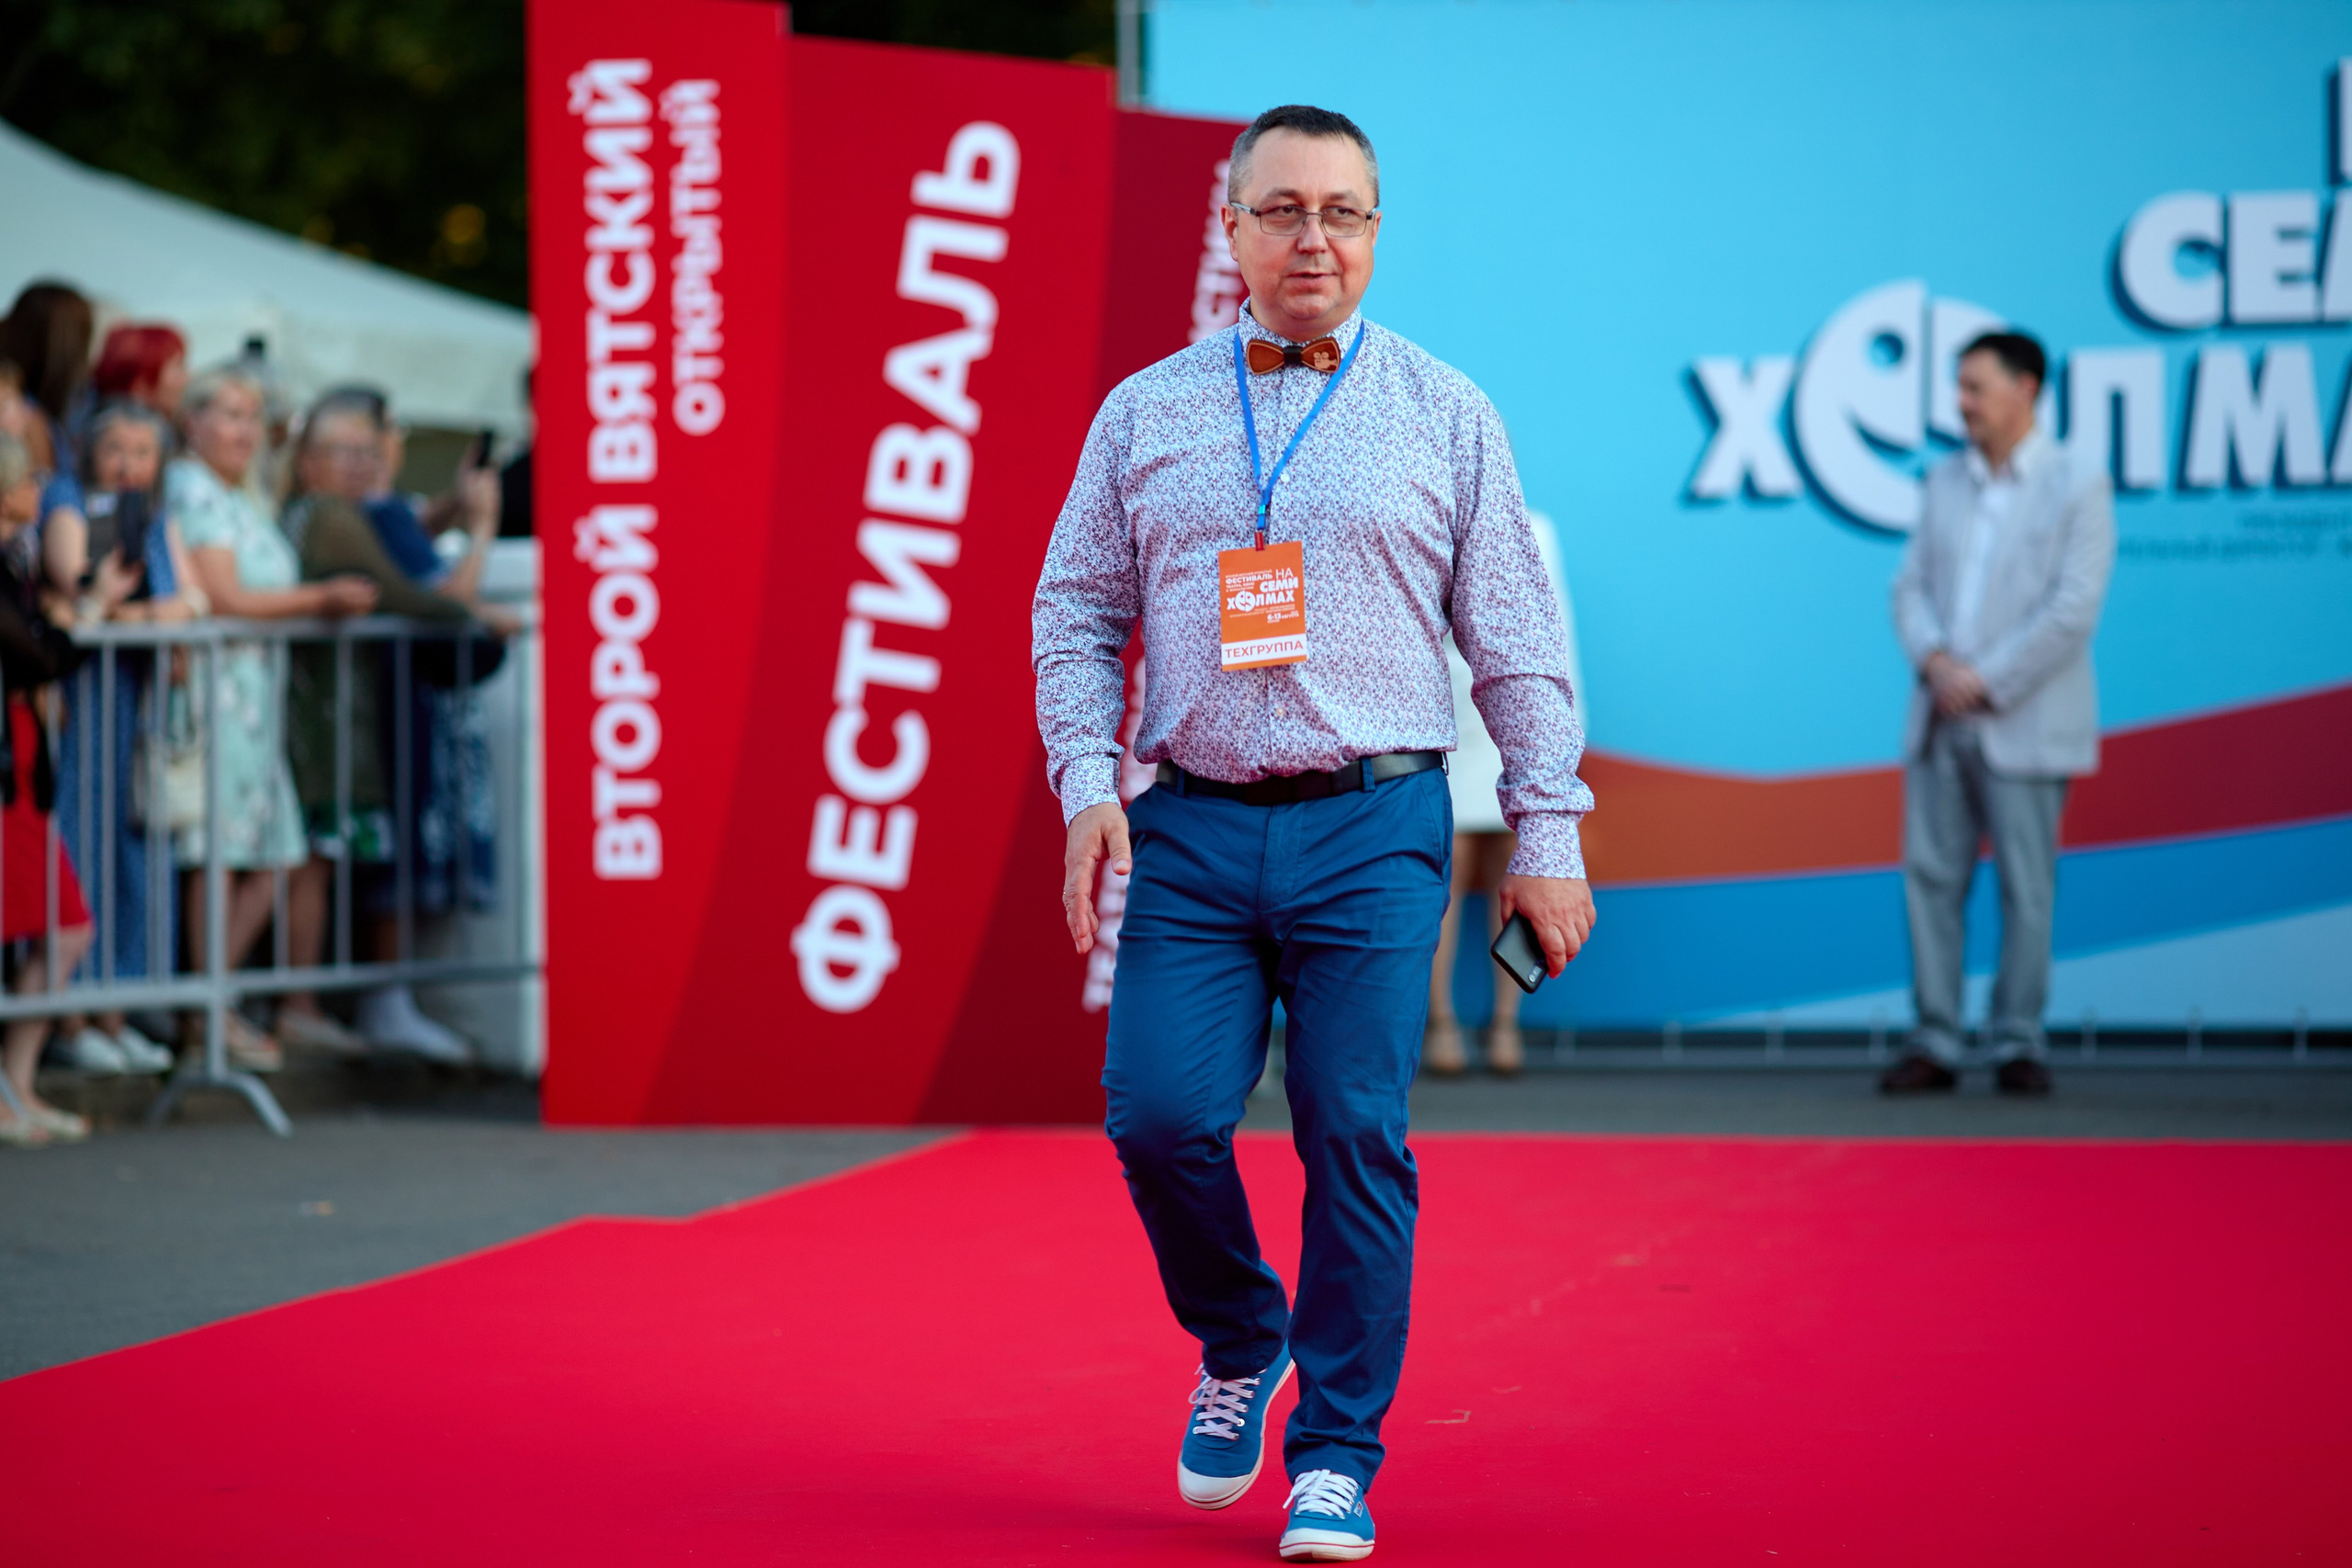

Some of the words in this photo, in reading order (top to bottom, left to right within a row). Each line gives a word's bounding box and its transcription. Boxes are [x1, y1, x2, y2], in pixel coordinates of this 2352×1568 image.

[568, 58, 656, 483] ВЯТСКИЙ
[661, 79, 725, 436] ОТКРЫТЫЙ
[2117, 191, 2352, 329] СЕ
[791, 121, 1020, 1013] ФЕСТИВАЛЬ
[1226, 573, 1273, 584] ФЕСТИВАЛЬ
[1227, 590, 1295, 612] ХОЛМАХ
[1260, 577, 1299, 592] СЕМИ
[1275, 567, 1294, 579] НА
[1225, 640, 1304, 659] ТЕХГРУППА
[575, 504, 662, 879] ВТОРОЙ
